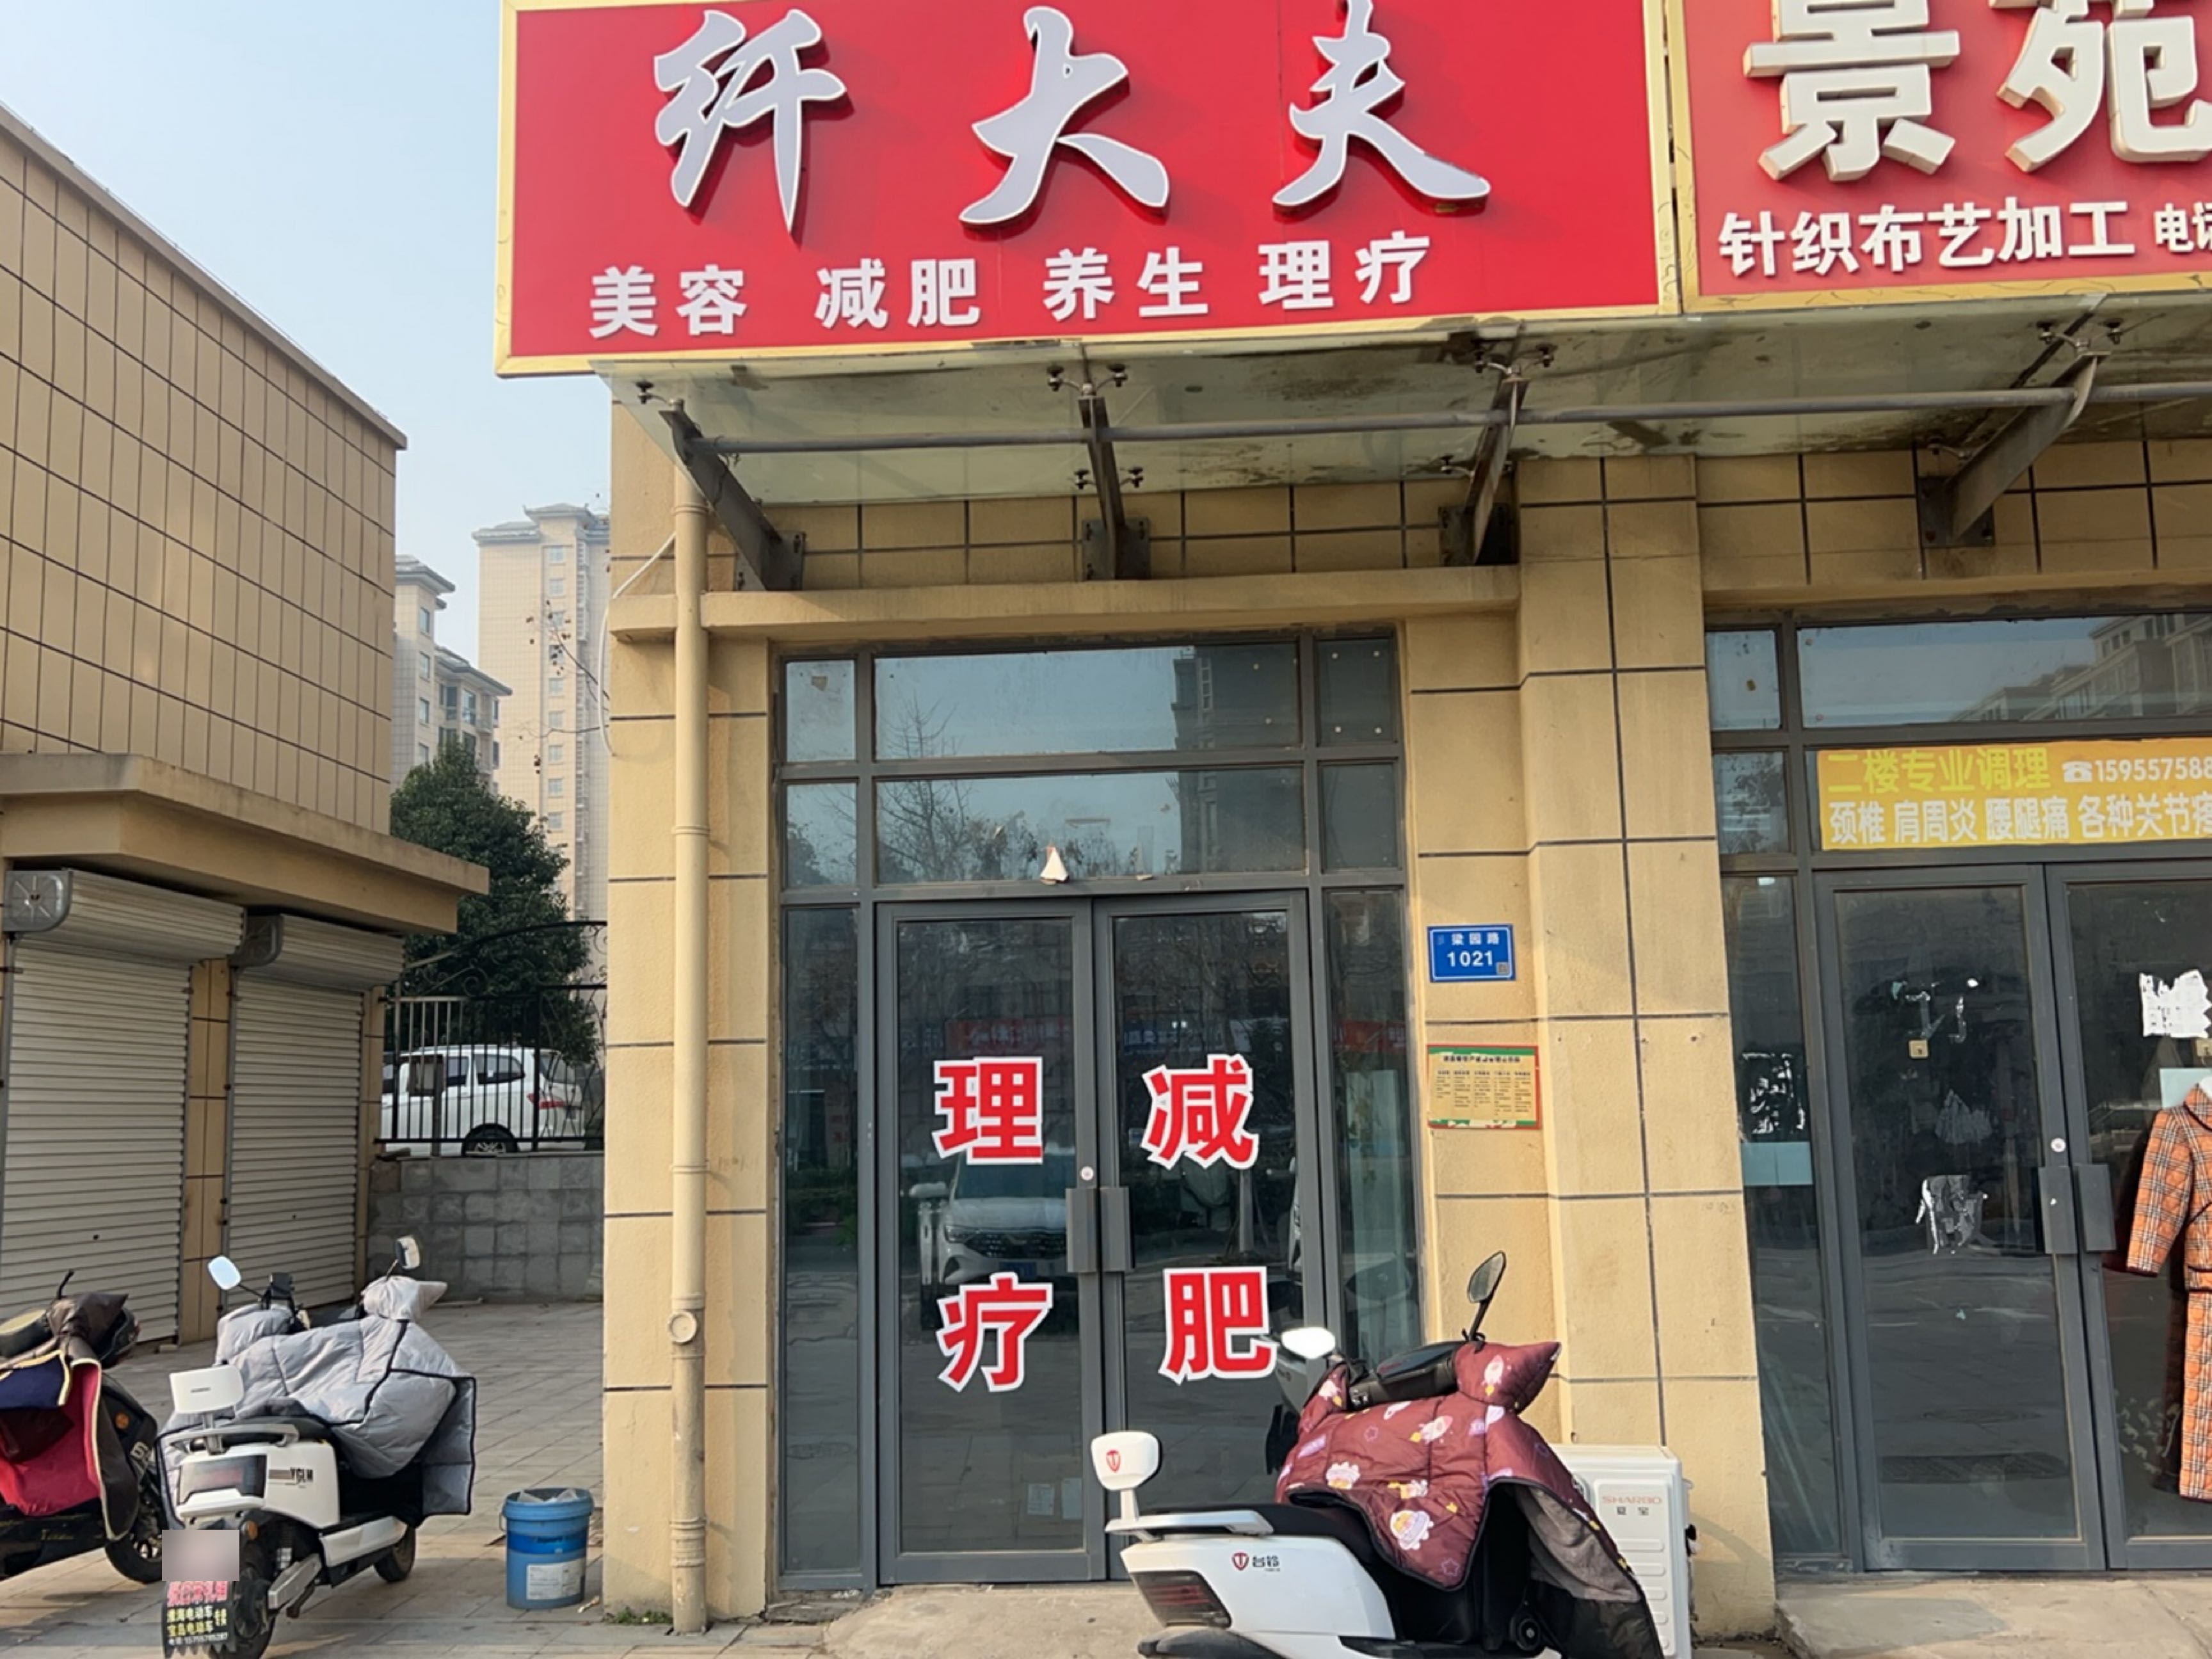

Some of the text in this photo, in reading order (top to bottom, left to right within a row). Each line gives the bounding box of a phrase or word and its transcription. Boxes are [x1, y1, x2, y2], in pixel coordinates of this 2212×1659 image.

[653, 0, 1490, 234] 纤大夫
[1743, 0, 2212, 182] 景苑
[1719, 196, 2135, 276] 针织布艺加工
[589, 230, 1431, 338] 美容 减肥 养生 理疗
[1827, 747, 2051, 794] 二楼专业调理
[1828, 800, 1886, 846] 颈椎
[1893, 797, 1978, 844] 肩周炎
[1985, 793, 2071, 841] 腰腿痛
[1447, 950, 1493, 967] 1021
